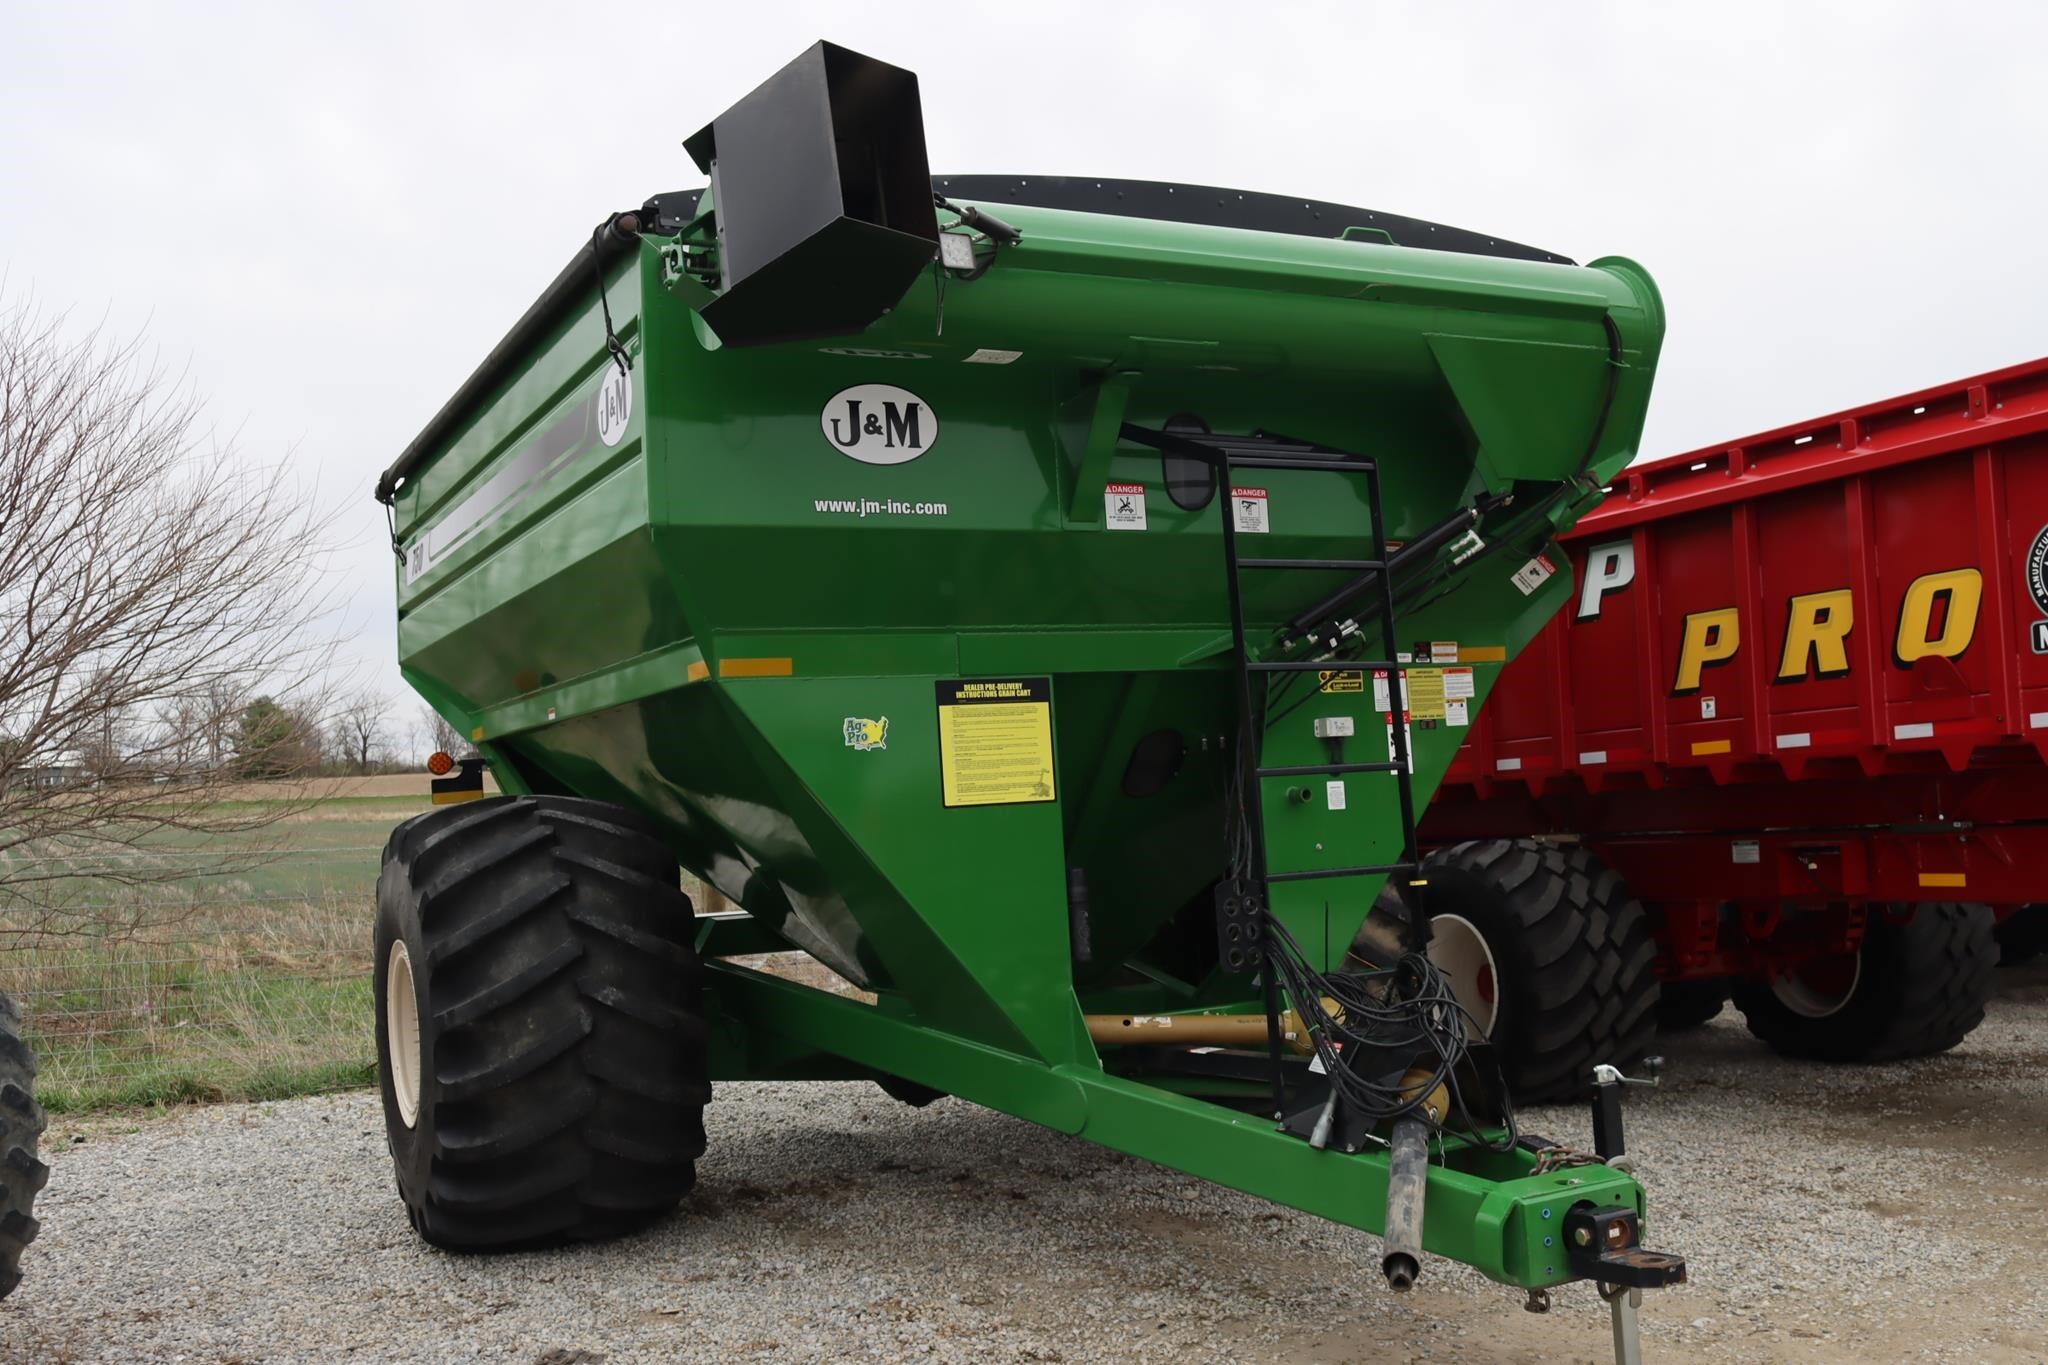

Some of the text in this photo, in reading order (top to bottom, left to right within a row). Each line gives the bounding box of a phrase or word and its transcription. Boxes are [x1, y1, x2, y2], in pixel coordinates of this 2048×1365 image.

[600, 378, 628, 436] J&M
[830, 399, 922, 449] J&M
[1112, 485, 1144, 494] DANGER
[1237, 488, 1266, 497] DANGER
[814, 498, 948, 518] www.jm-inc.com
[2032, 530, 2048, 598] MANUFACTU
[963, 682, 1023, 692] DEALER PRE-DELIVERY
[956, 689, 1031, 699] INSTRUCTIONS GRAIN CART
[846, 720, 867, 733] Ag-
[847, 731, 868, 744] Pro
